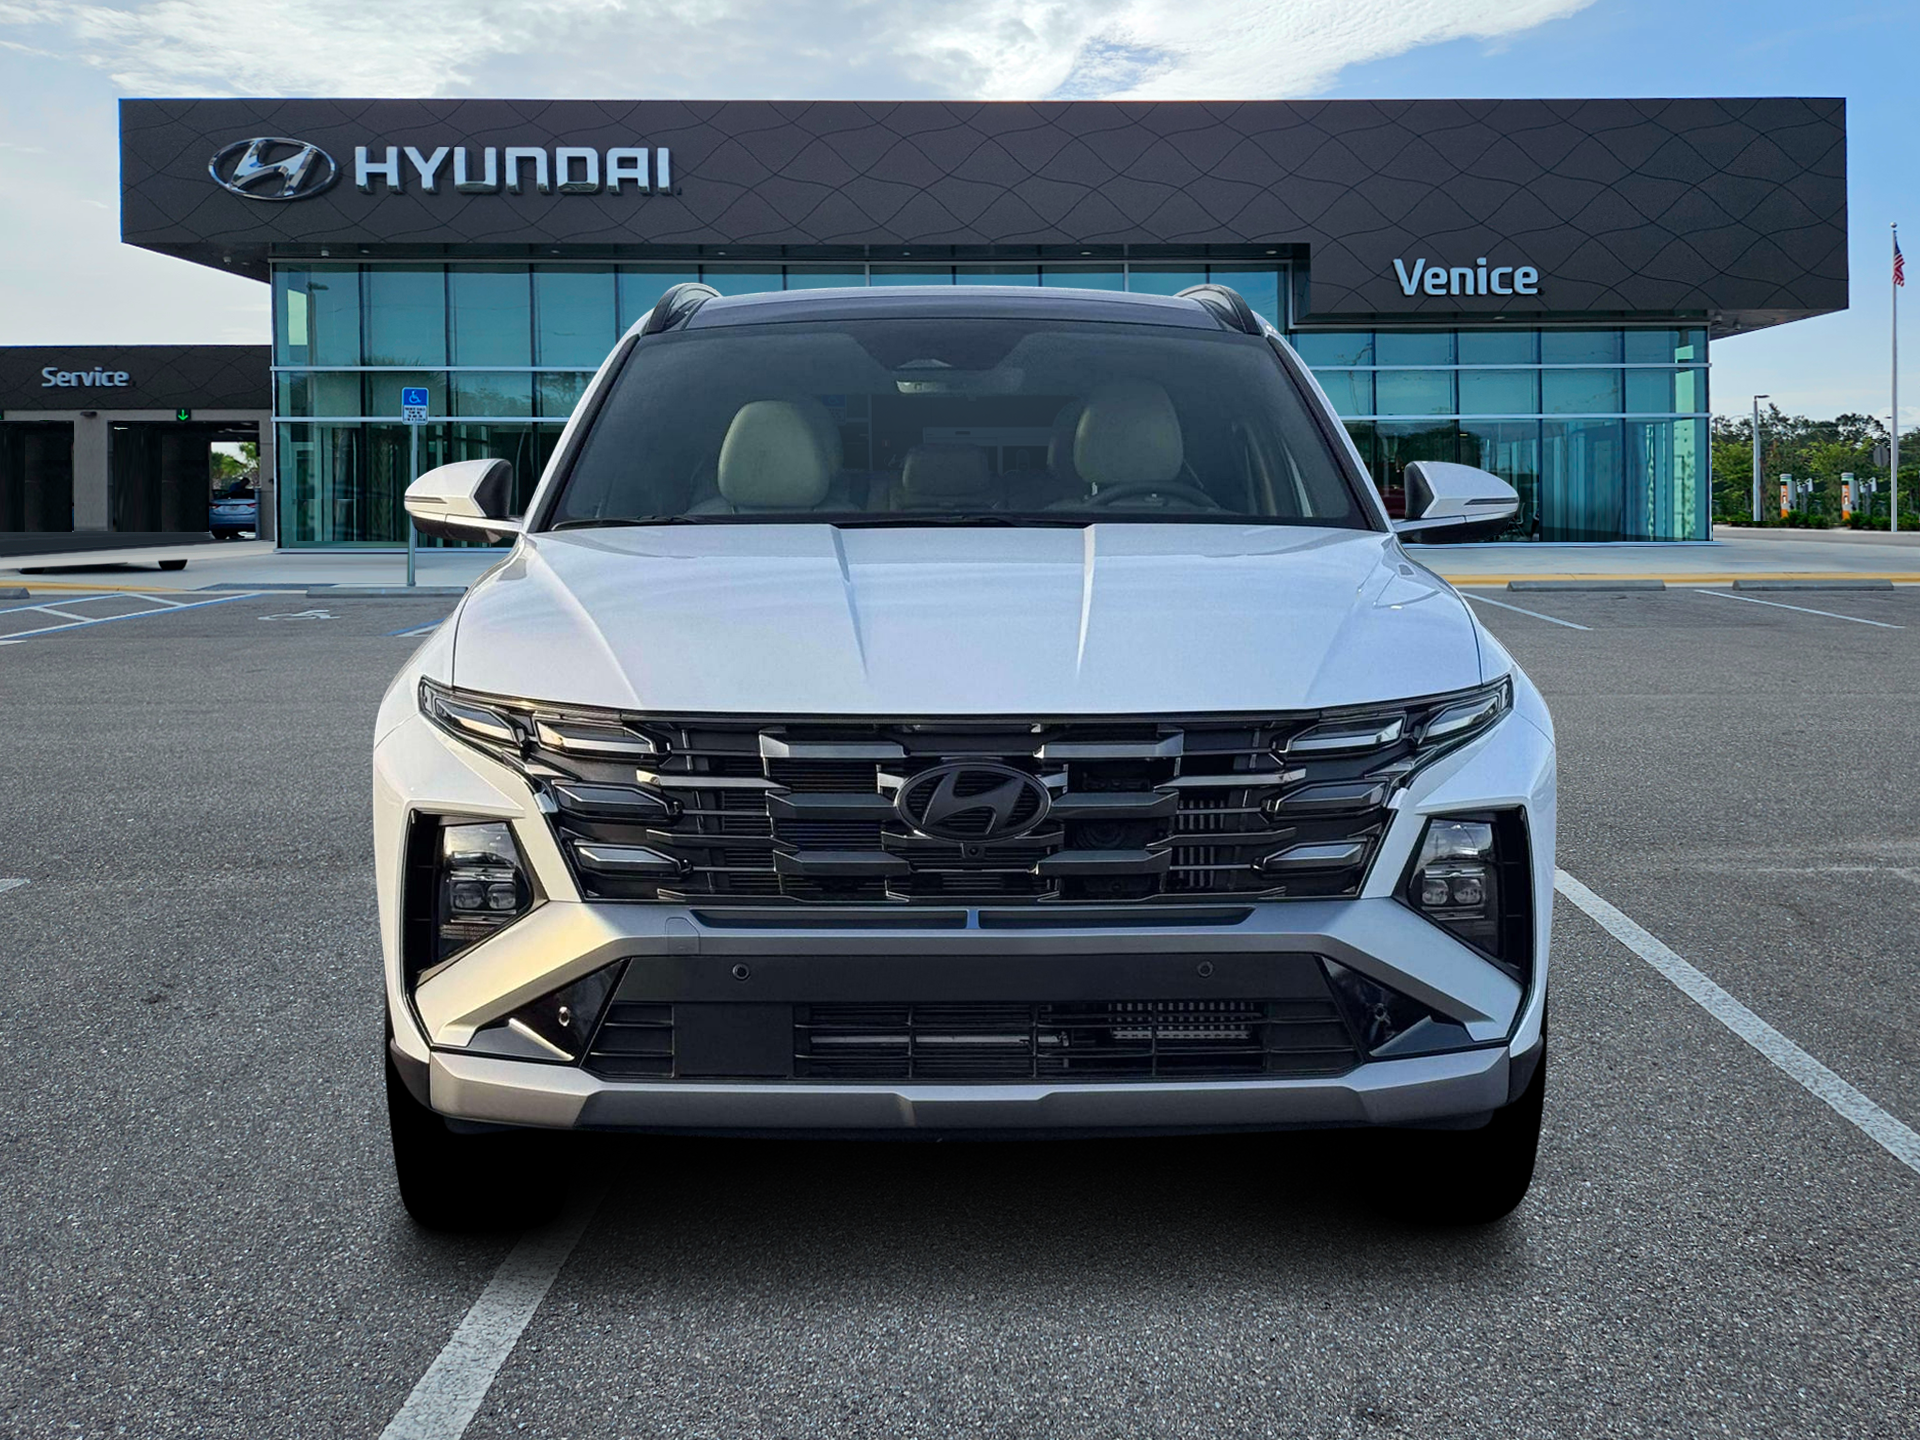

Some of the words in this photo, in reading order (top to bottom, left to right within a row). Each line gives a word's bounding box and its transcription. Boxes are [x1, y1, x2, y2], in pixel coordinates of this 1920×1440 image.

[355, 146, 671, 194] HYUNDAI
[1392, 257, 1539, 296] Venice
[41, 366, 130, 387] Service
